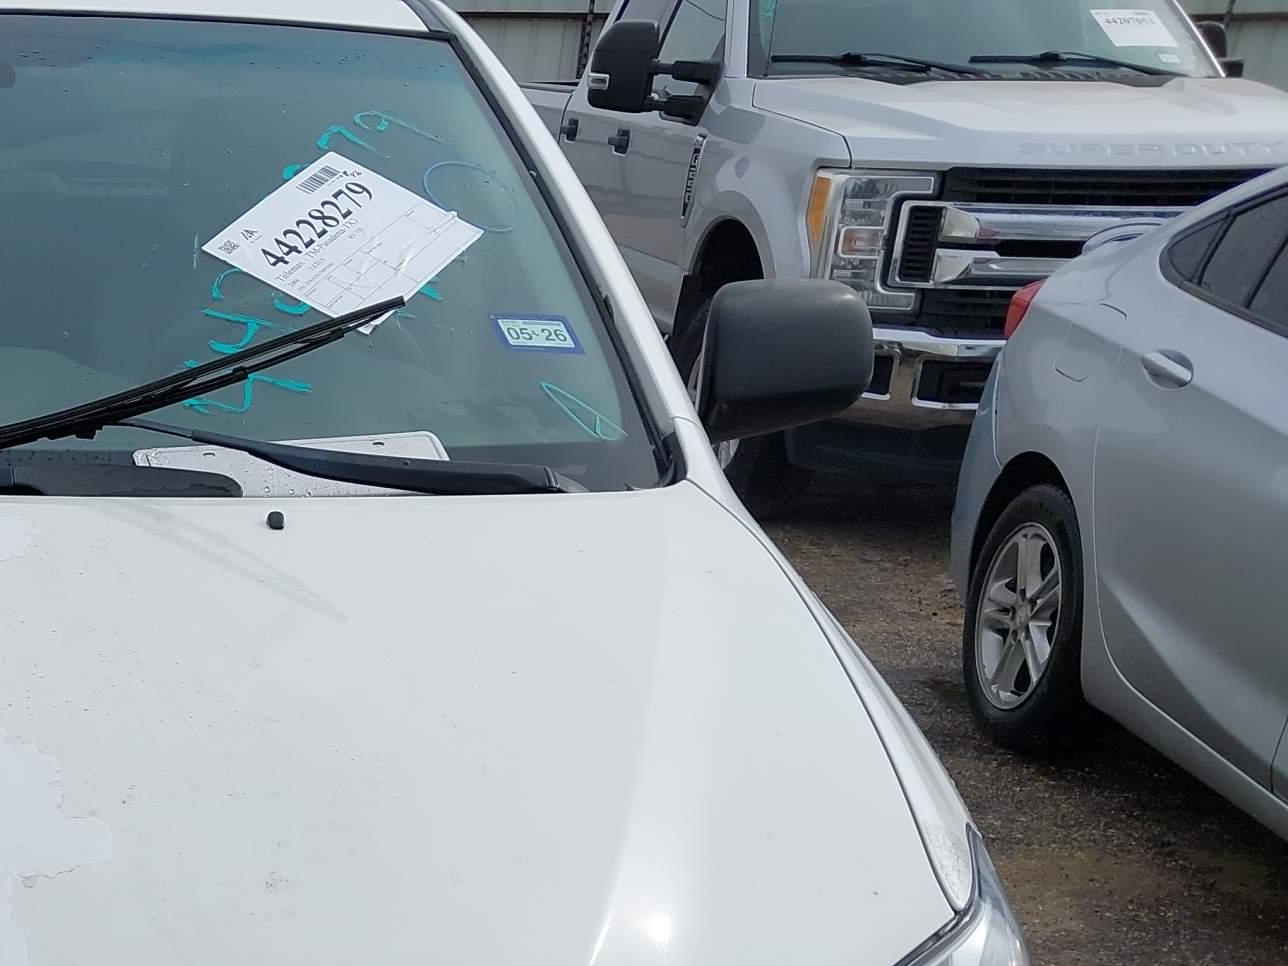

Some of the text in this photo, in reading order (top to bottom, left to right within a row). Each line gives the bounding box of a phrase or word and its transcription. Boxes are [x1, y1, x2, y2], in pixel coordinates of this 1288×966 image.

[1016, 141, 1284, 157] SUPER DUTY
[259, 181, 373, 269] 44228279
[506, 327, 568, 342] 05 26
